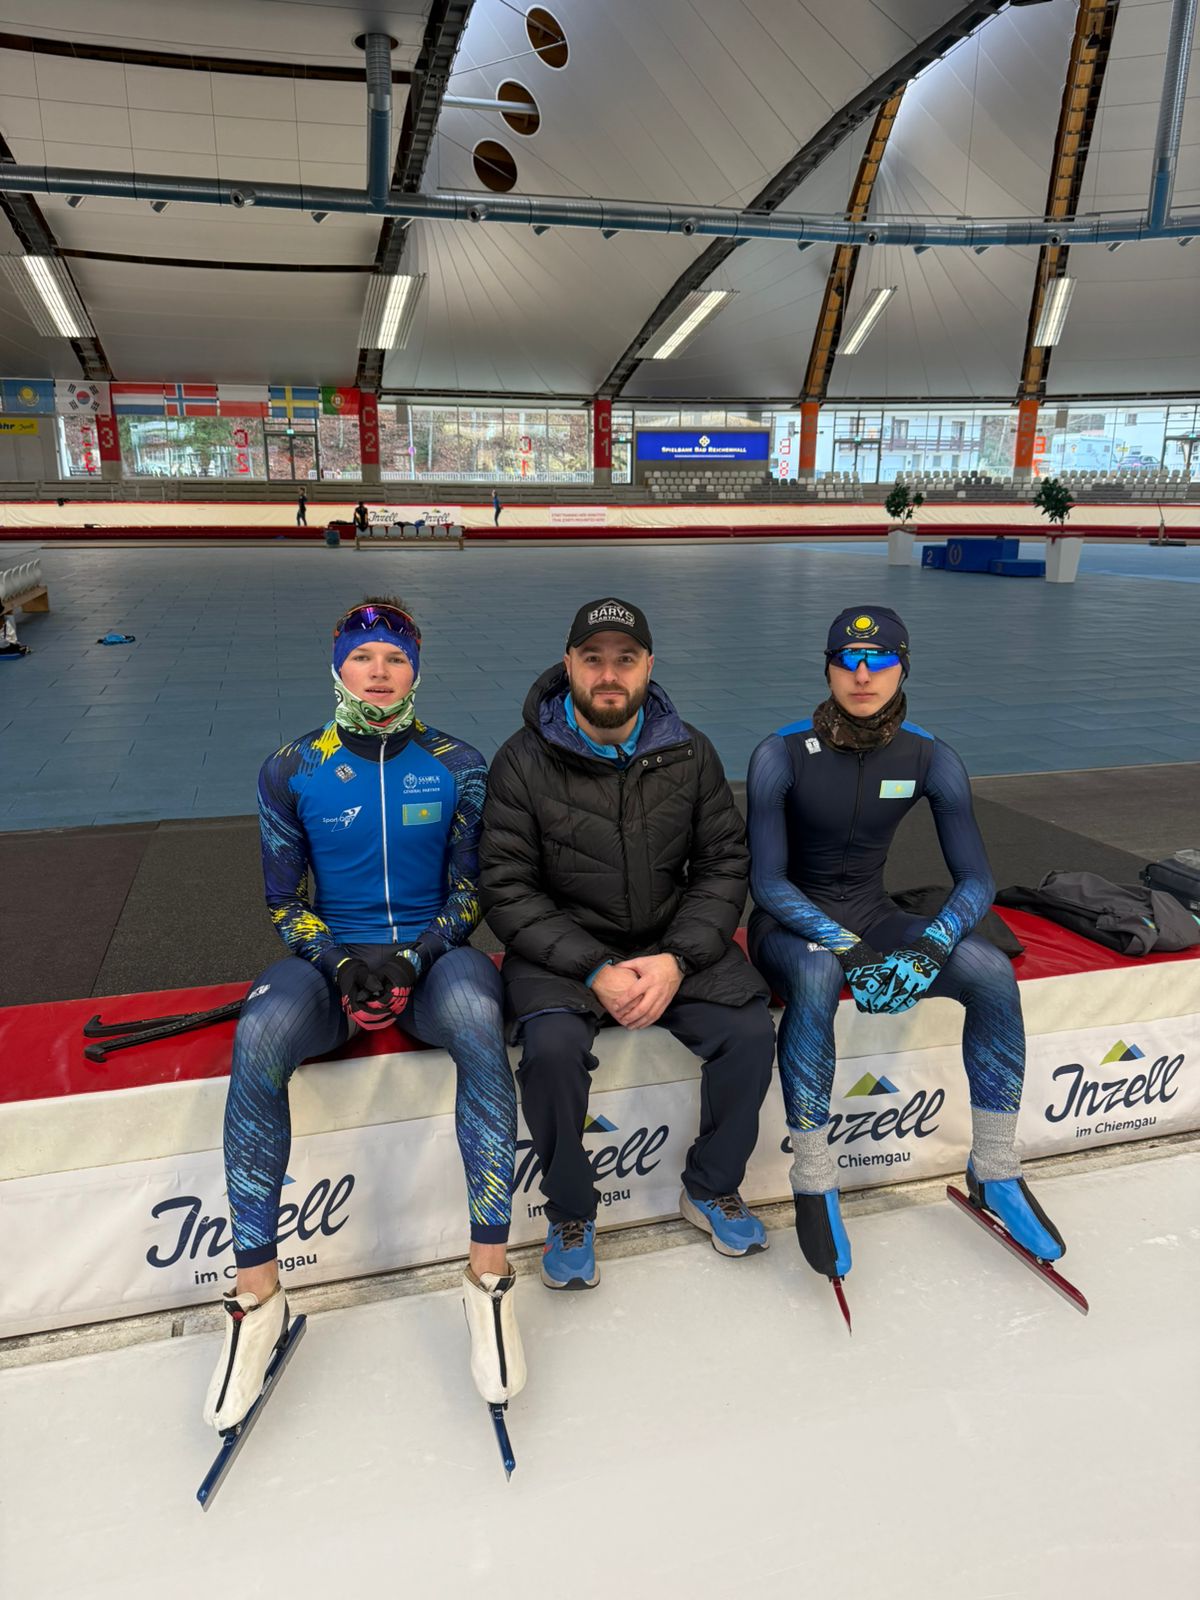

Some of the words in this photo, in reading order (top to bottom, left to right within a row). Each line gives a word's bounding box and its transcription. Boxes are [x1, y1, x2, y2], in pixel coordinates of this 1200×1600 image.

[926, 550, 933, 563] 2
[590, 607, 635, 622] BARYS
[1045, 1054, 1185, 1122] Inzell
[781, 1088, 945, 1154] nzell
[1075, 1126, 1091, 1138] im
[1094, 1116, 1157, 1134] Chiemgau
[837, 1152, 911, 1169] Chiemgau
[146, 1174, 356, 1268] Inell
[194, 1270, 218, 1285] im
